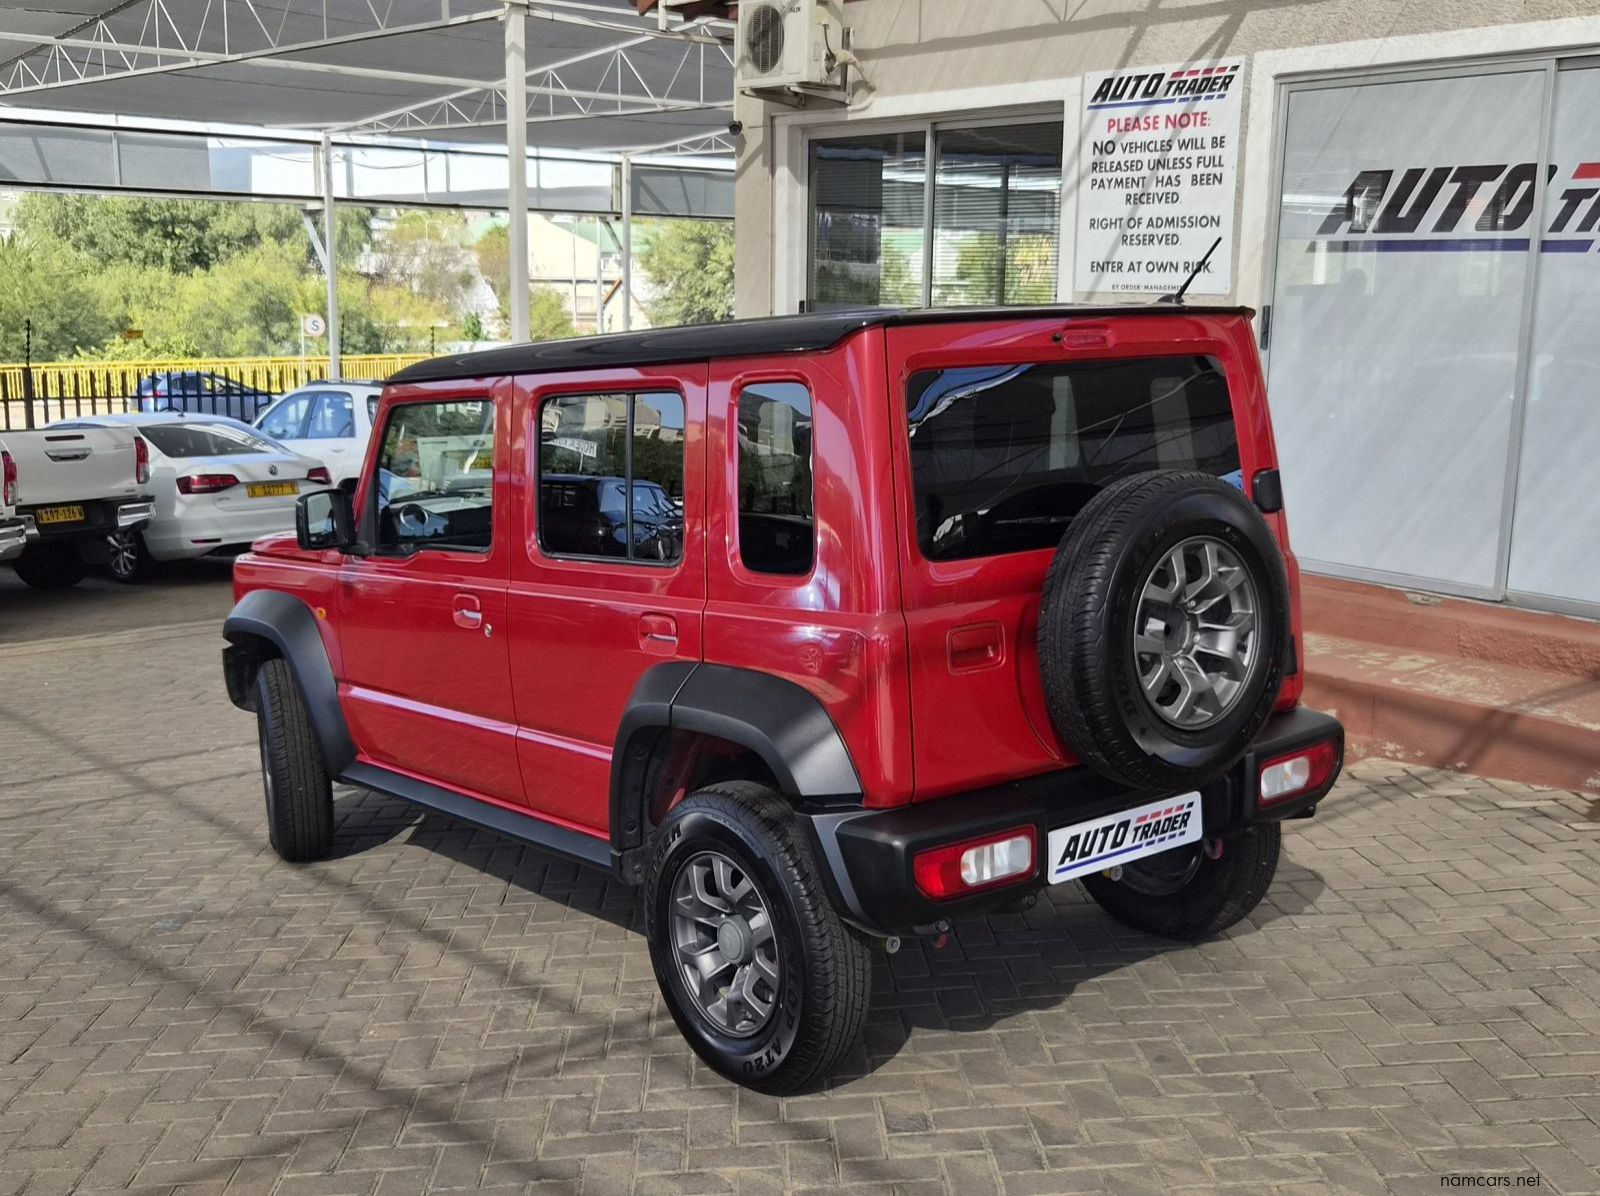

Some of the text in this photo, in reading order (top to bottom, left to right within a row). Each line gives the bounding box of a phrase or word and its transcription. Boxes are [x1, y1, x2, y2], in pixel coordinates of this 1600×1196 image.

[1090, 73, 1235, 103] AUTO TRADER
[1107, 111, 1210, 133] PLEASE NOTE:
[1092, 136, 1225, 156] NO VEHICLES WILL BE
[1091, 155, 1224, 173] RELEASED UNLESS FULL
[1090, 173, 1223, 190] PAYMENT HAS BEEN
[1125, 192, 1182, 205] RECEIVED.
[1315, 163, 1558, 235] AUTO
[1089, 215, 1220, 230] RIGHT OF ADMISSION
[1121, 233, 1181, 246] RESERVED.
[1090, 261, 1123, 273] ENTER
[1127, 261, 1142, 273] AT
[1145, 261, 1179, 273] OWN
[312, 320, 319, 330] S
[1058, 811, 1191, 866] AUTO TRADER
